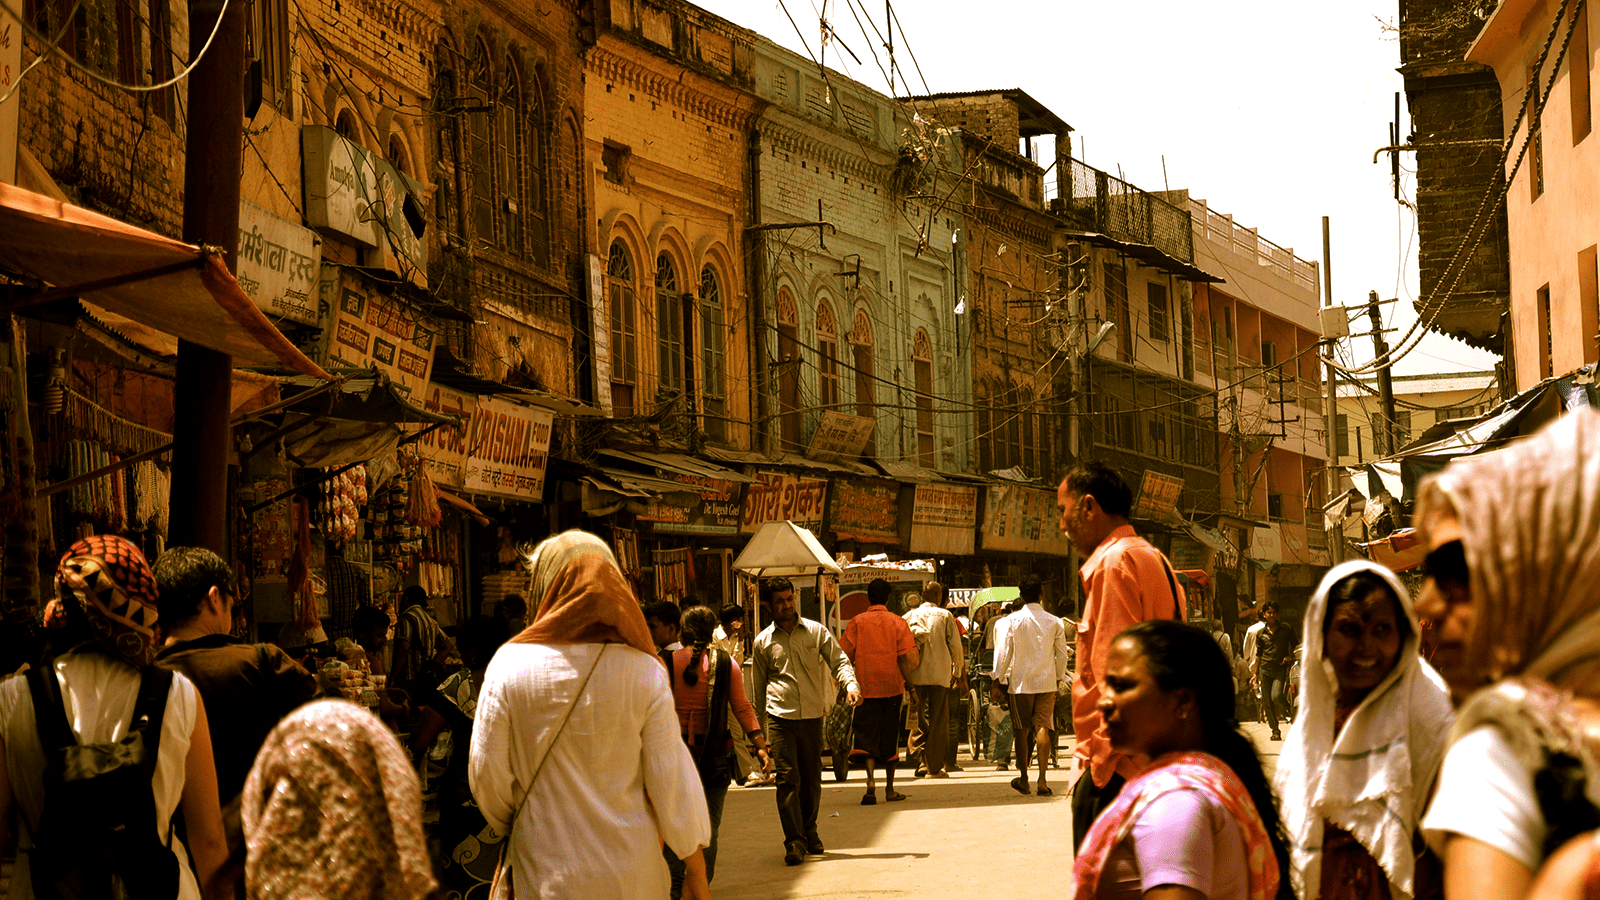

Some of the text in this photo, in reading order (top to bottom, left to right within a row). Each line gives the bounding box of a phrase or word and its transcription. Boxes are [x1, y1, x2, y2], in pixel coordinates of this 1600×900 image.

[472, 406, 532, 468] KRISHNA
[531, 422, 549, 444] FOOD
[529, 448, 548, 470] POINT
[844, 571, 889, 579] ENTERPRISES
